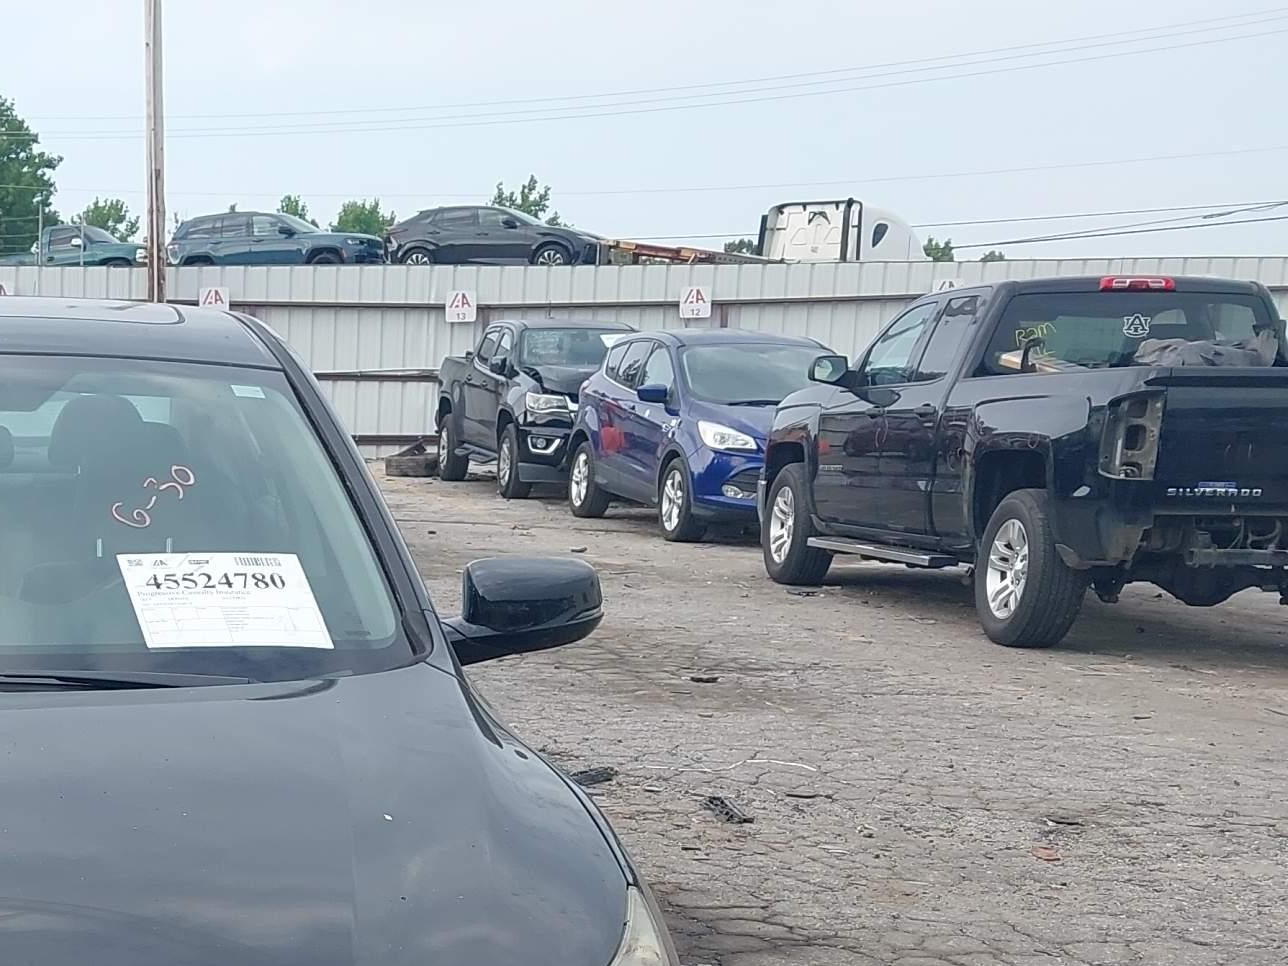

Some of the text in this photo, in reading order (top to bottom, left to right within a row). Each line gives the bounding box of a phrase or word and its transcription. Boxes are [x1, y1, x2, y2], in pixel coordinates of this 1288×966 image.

[456, 312, 466, 321] 13
[690, 308, 701, 317] 12
[1166, 487, 1263, 497] SILVERADO
[145, 571, 287, 590] 45524780
